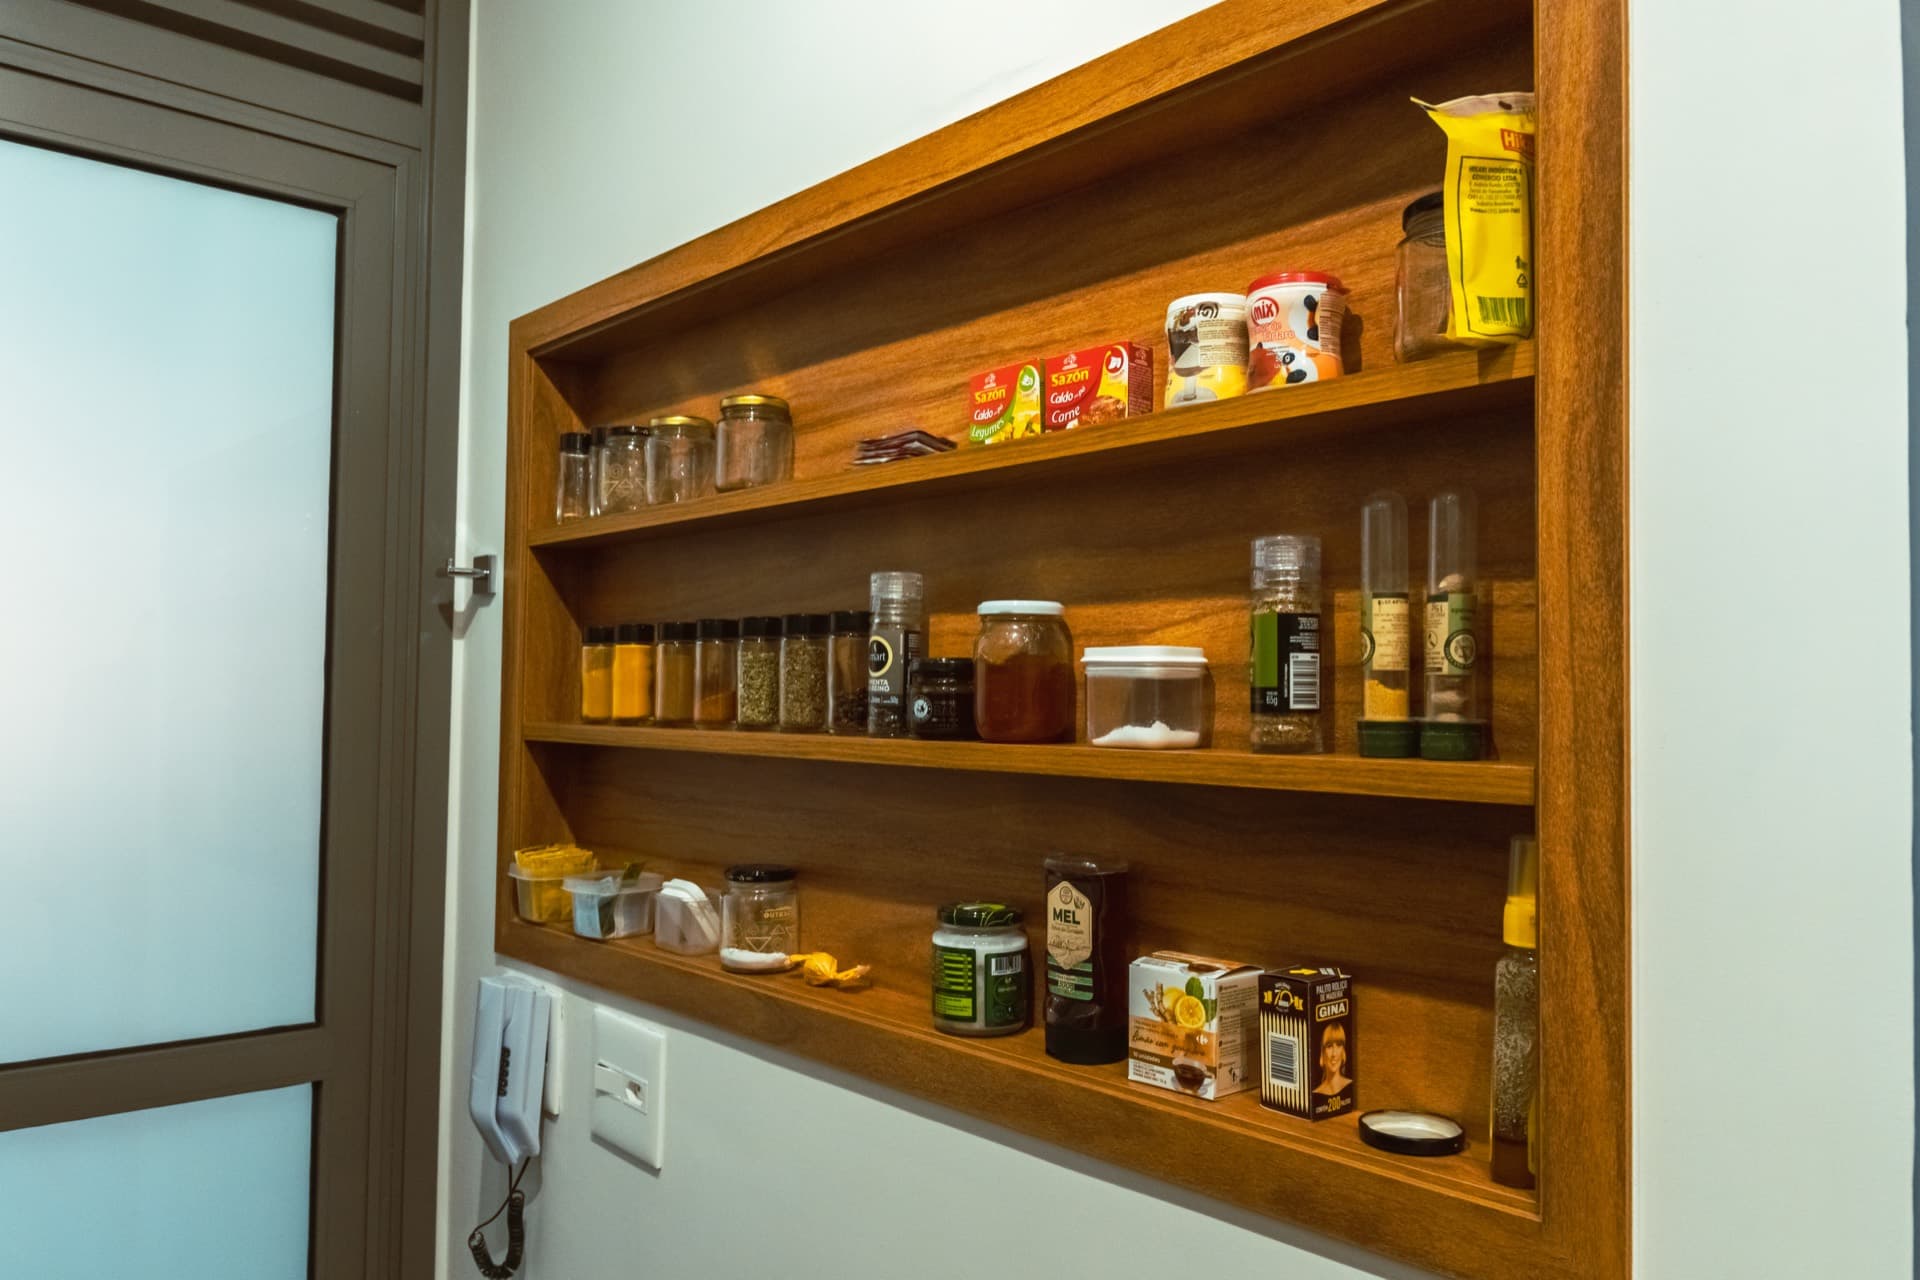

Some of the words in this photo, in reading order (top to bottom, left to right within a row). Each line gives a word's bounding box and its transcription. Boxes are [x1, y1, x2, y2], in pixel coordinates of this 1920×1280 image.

[1253, 301, 1275, 321] mix
[1050, 390, 1074, 404] Caldo
[974, 408, 994, 420] Caldo
[1051, 406, 1080, 424] Carne
[1053, 907, 1081, 925] MEL
[1319, 1002, 1346, 1018] GINA
